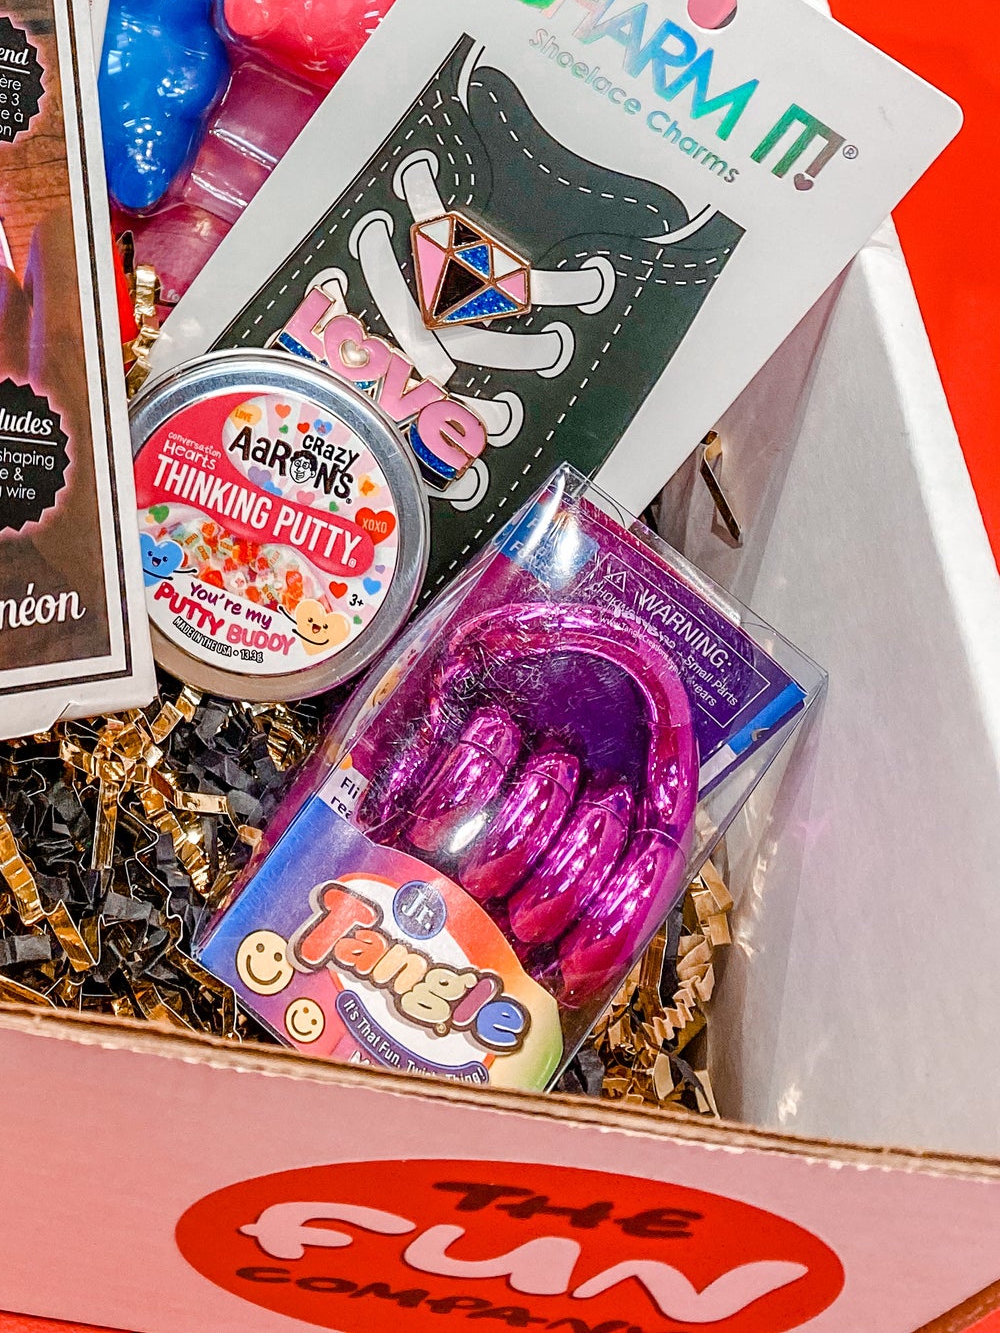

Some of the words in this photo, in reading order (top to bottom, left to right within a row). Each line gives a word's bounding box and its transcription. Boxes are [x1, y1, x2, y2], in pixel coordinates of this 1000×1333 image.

[11, 93, 20, 106] 3
[14, 109, 24, 123] à
[529, 28, 642, 116] Shoelace
[646, 109, 742, 185] Charms
[750, 103, 846, 191] IT!
[163, 439, 217, 470] Hearts
[168, 431, 222, 458] conversation
[6, 483, 36, 500] wire
[13, 467, 24, 482] &
[153, 454, 273, 530] THINKING
[273, 508, 363, 566] PUTTY
[362, 517, 387, 534] XOXO
[154, 581, 225, 636] PUTTY
[226, 623, 296, 656] BUDDY
[190, 581, 242, 615] You're
[245, 607, 273, 630] my
[349, 593, 364, 608] 3+
[173, 615, 195, 638] MADE
[192, 630, 203, 644] IN
[201, 635, 218, 651] THE
[216, 642, 232, 657] USA
[240, 648, 263, 663] 13.3g
[641, 589, 732, 672] WARNING:
[685, 655, 713, 682] Small
[711, 678, 738, 706] Parts
[340, 776, 360, 799] Fli
[401, 891, 433, 930] Jr.
[297, 884, 530, 1054] Tangle
[343, 999, 359, 1021] It's
[356, 1017, 381, 1047] That
[378, 1042, 401, 1068] Fun,
[432, 1181, 706, 1240] THE
[237, 1200, 810, 1324] FUN
[235, 1266, 660, 1333] COMPAN
